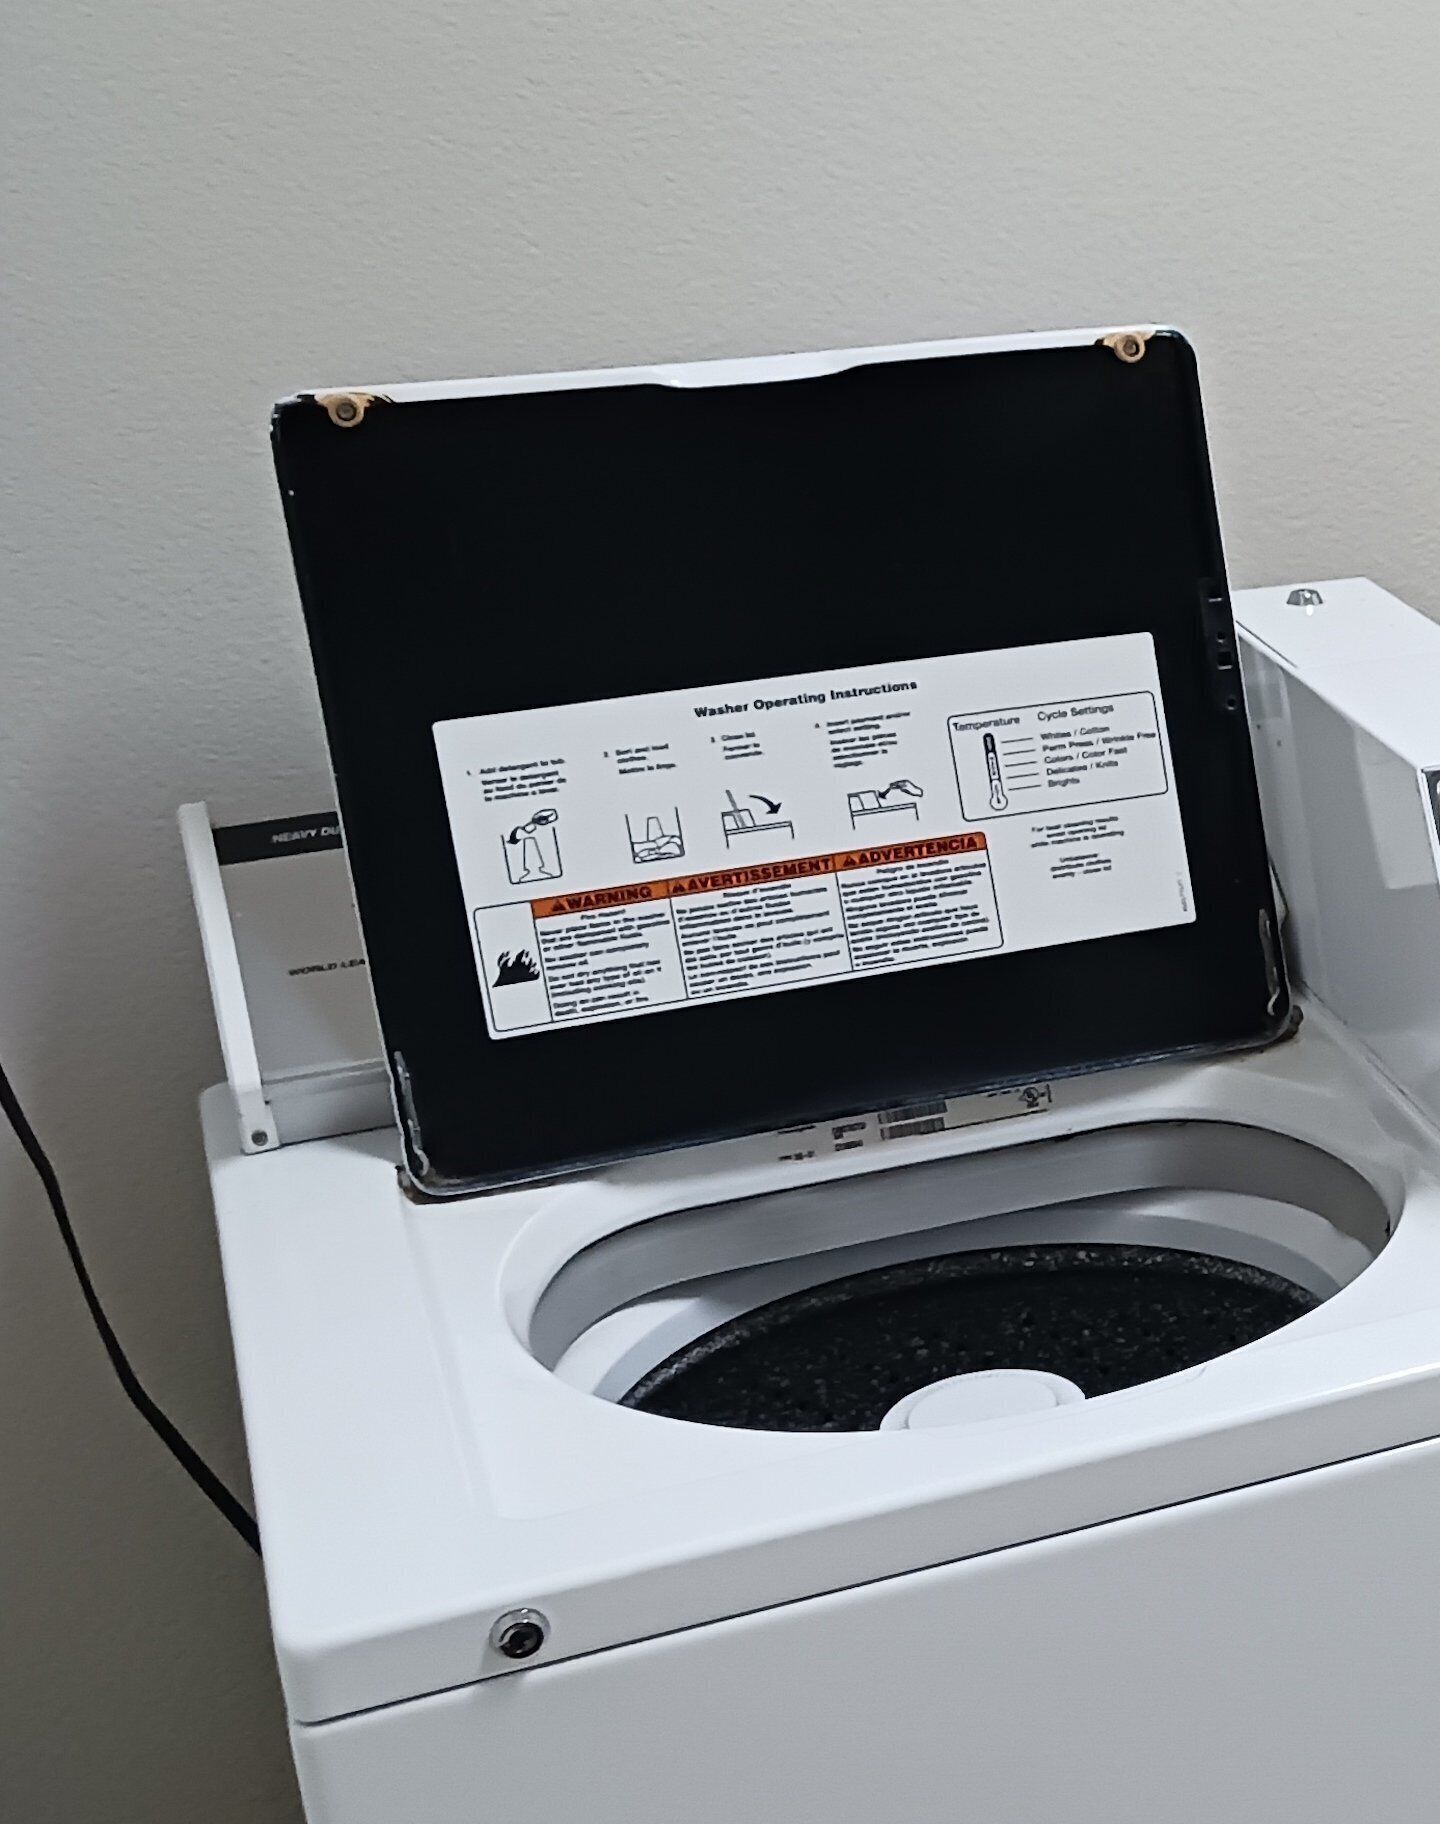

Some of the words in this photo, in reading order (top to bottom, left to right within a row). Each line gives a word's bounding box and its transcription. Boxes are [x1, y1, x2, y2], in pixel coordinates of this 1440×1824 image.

[693, 703, 748, 717] Washer
[753, 692, 826, 711] Operating
[830, 680, 917, 700] Instructions
[953, 716, 1020, 731] Temperature
[1037, 709, 1067, 722] Cycle
[1071, 704, 1114, 717] Settings
[271, 828, 317, 843] HEAVY
[858, 836, 978, 864] ADVERTENCIA
[688, 858, 832, 889] AVERTISSEMENT
[565, 885, 653, 908] WARNING
